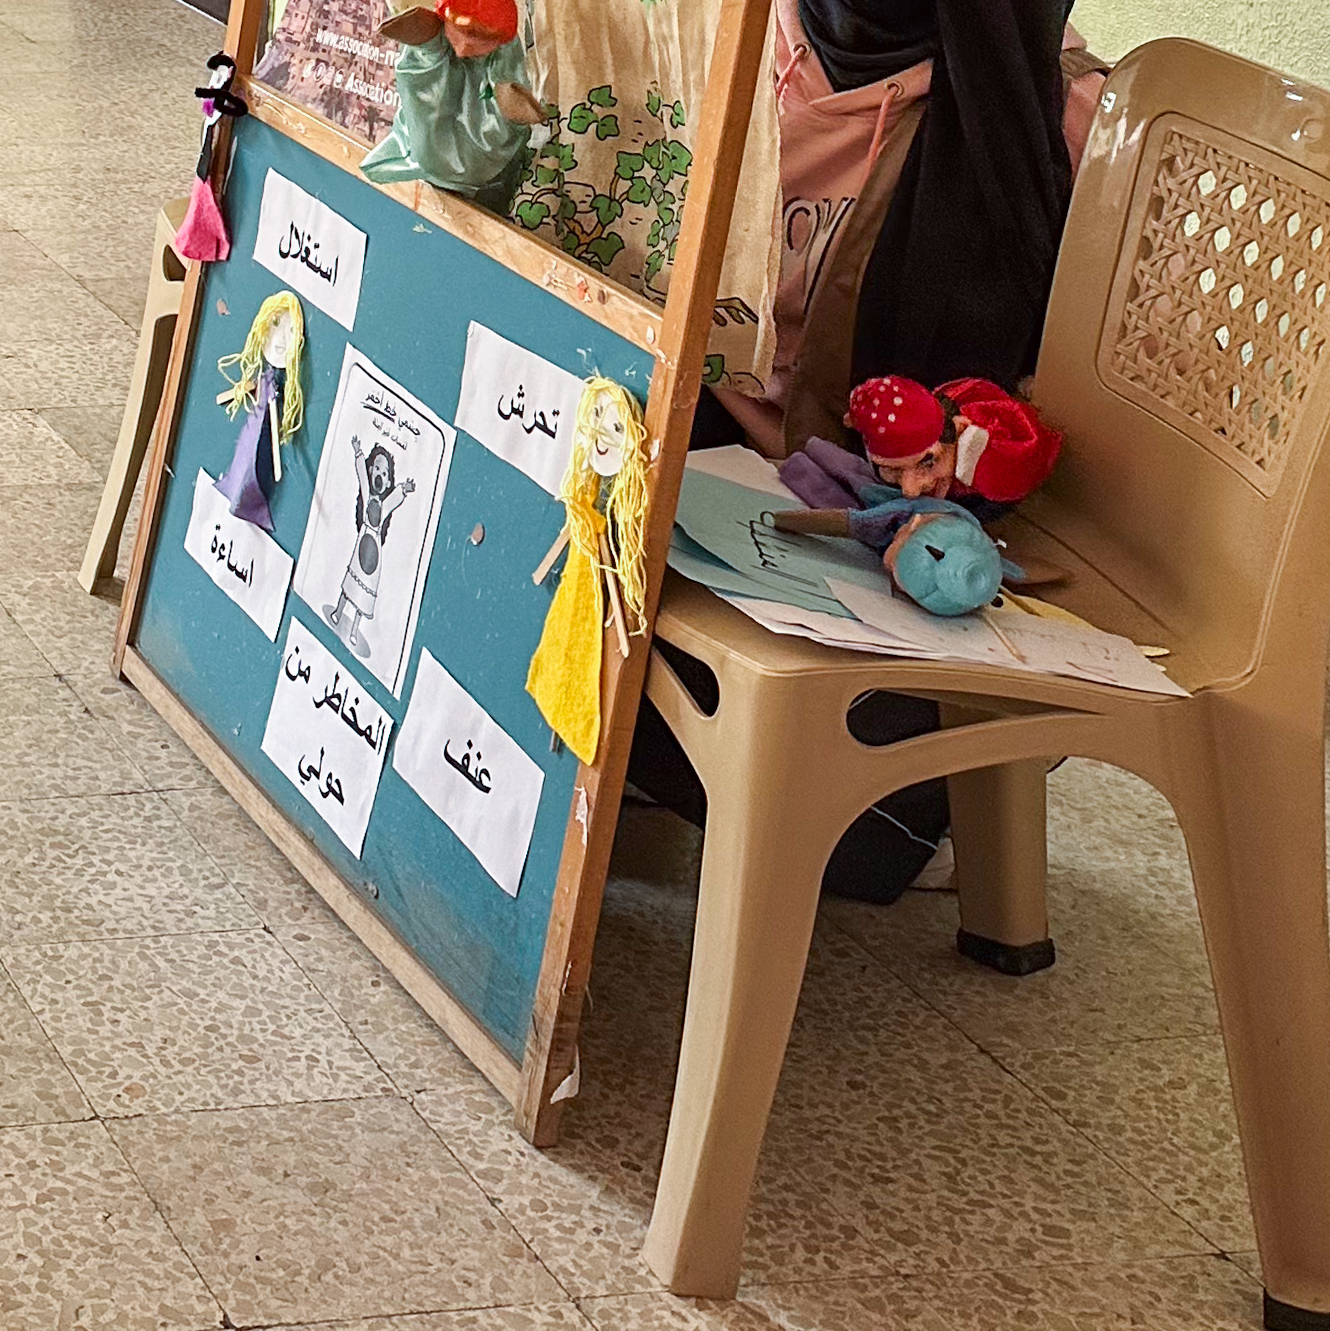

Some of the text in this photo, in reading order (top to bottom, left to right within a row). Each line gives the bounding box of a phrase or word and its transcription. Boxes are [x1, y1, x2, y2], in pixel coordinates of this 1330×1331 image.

[279, 219, 339, 288] استغلال
[496, 382, 560, 441] تحرش
[208, 523, 256, 589] اساءة
[284, 643, 387, 756] المخاطر من
[296, 744, 346, 808] حولي
[443, 732, 494, 796] عنف
